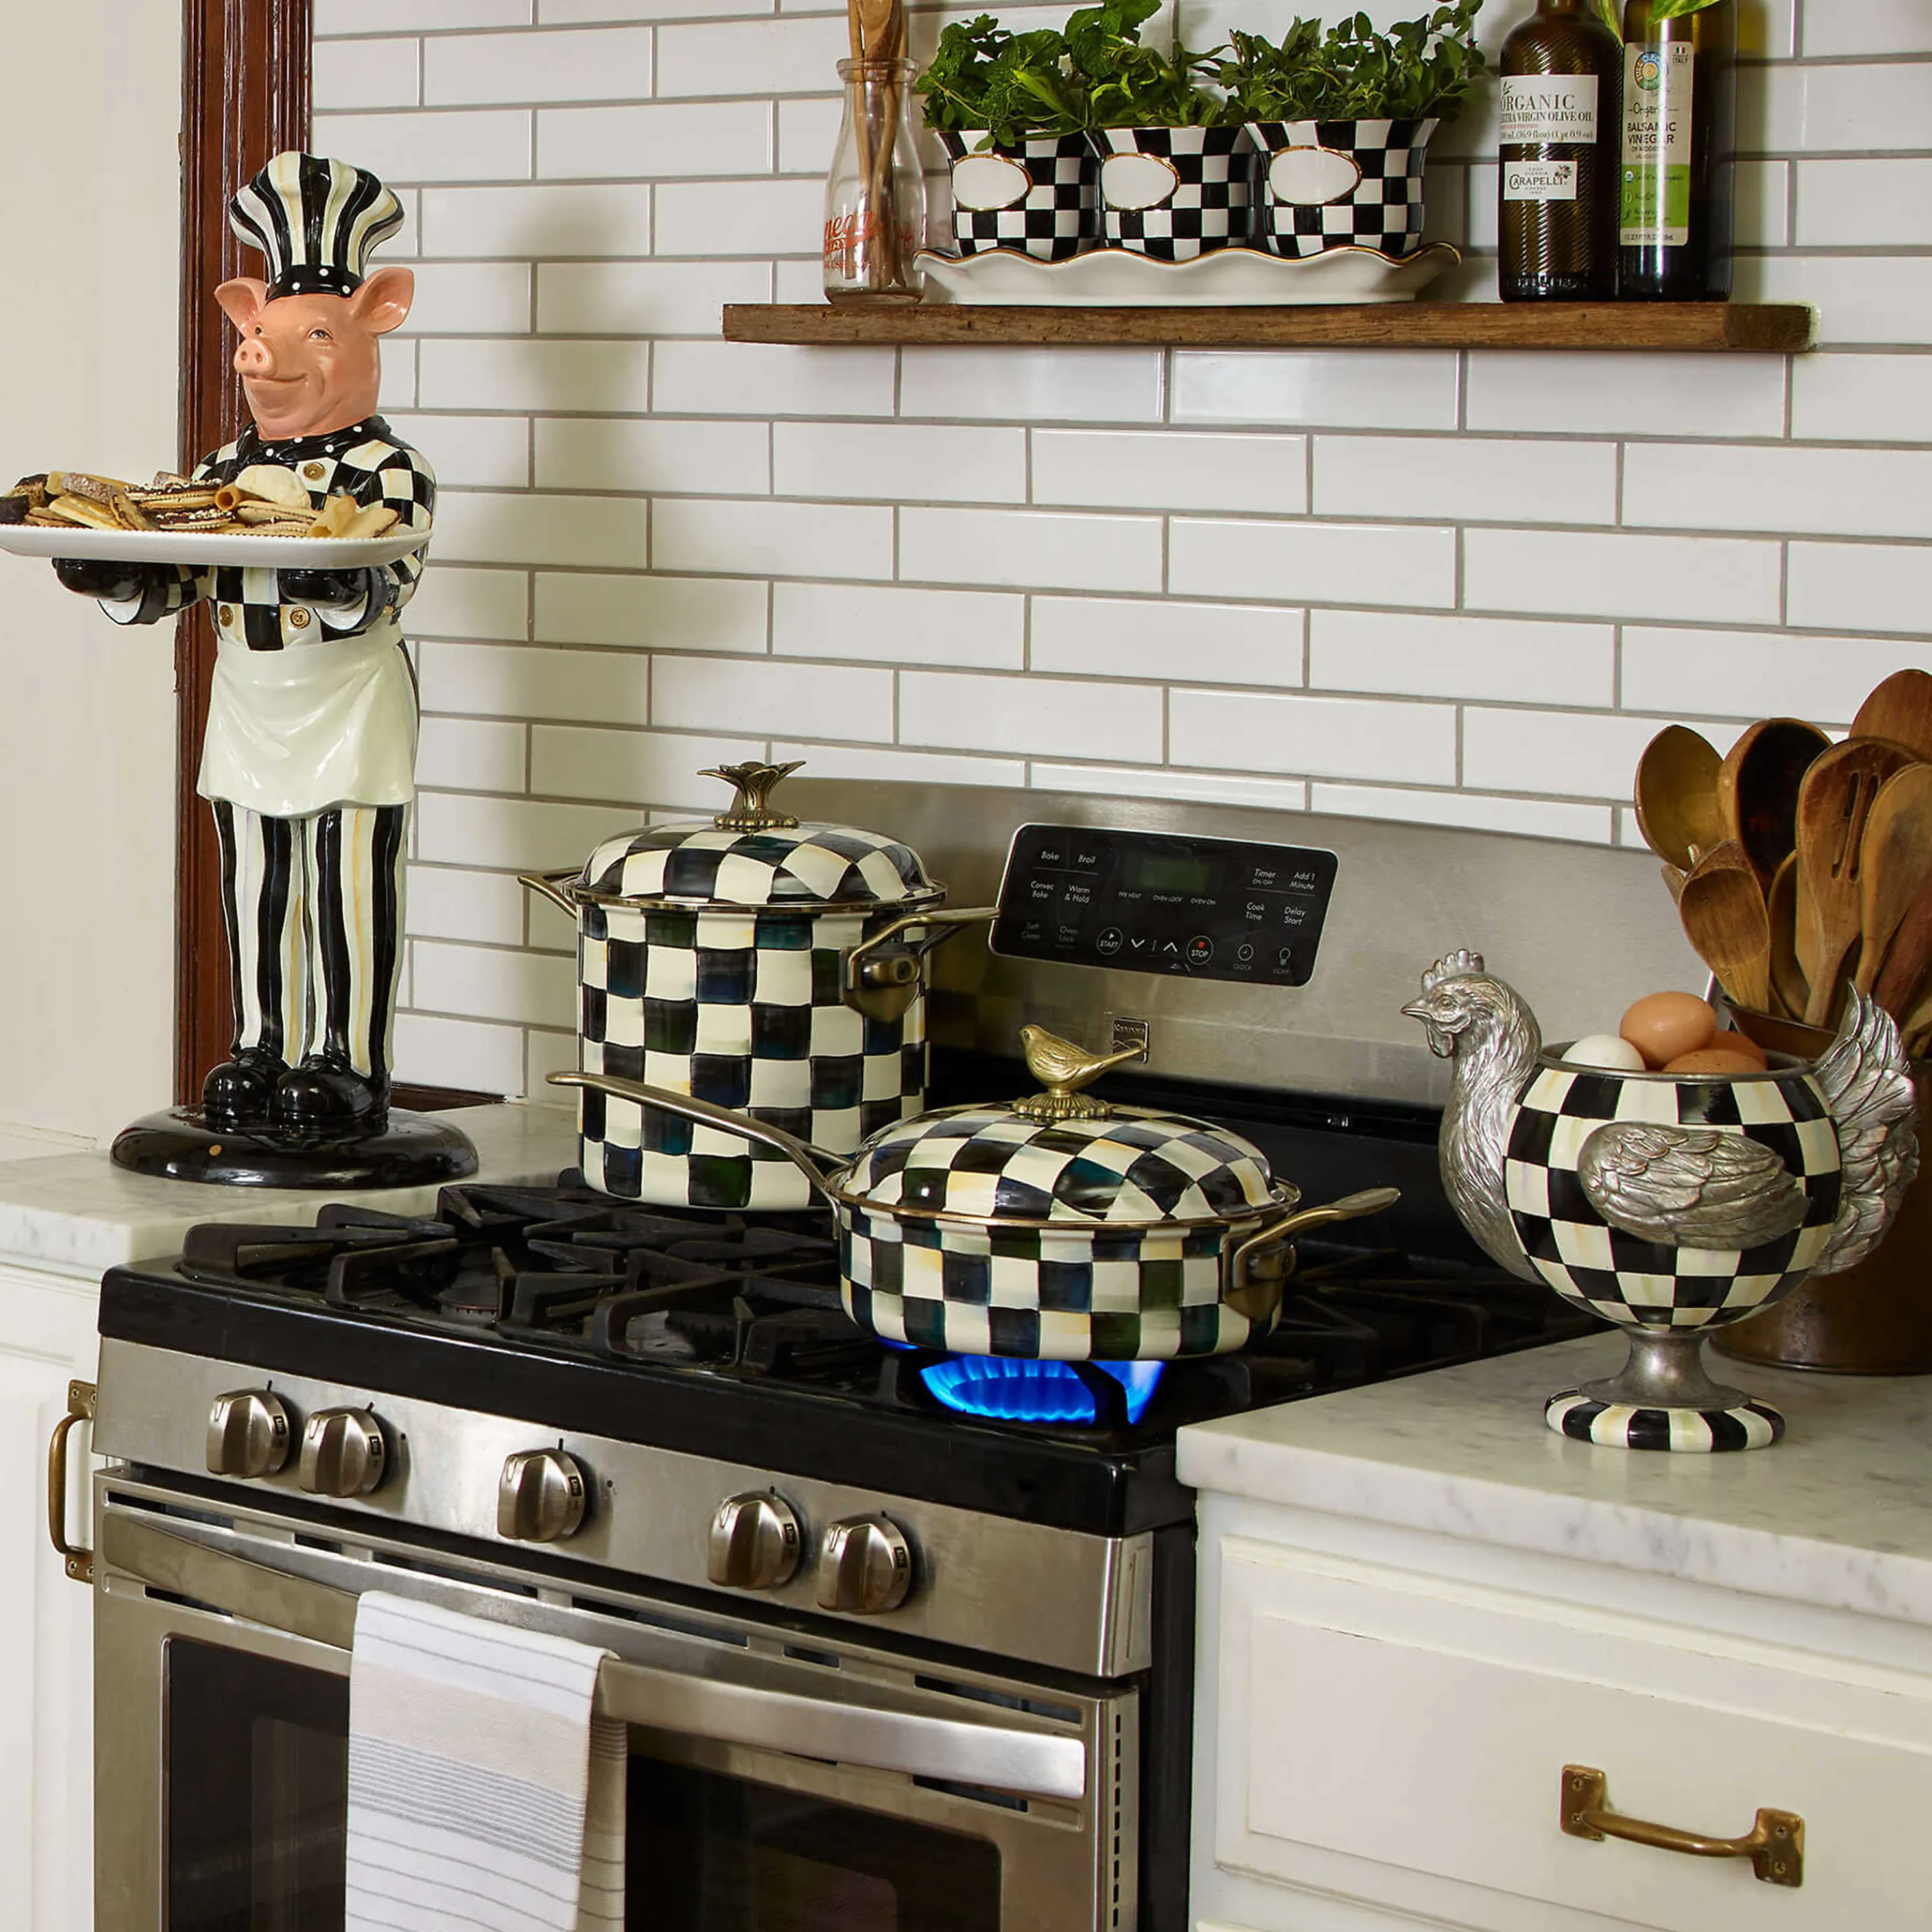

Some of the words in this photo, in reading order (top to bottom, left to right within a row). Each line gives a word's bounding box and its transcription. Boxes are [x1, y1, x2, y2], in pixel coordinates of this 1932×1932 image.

[1500, 94, 1575, 112] ORGANIC
[1634, 102, 1664, 117] Organ
[1516, 112, 1546, 123] VIRGIN
[1548, 112, 1577, 122] OLIVE
[1577, 112, 1594, 122] OIL
[1628, 134, 1675, 144] VINEGR
[1509, 173, 1563, 190] CARAPELLI
[1041, 850, 1059, 860] Bake
[1078, 854, 1096, 864] Broil
[1255, 868, 1277, 878] Timer
[1293, 871, 1310, 880] Add
[1312, 873, 1316, 882] 1
[1030, 880, 1055, 890] Convec
[1068, 884, 1090, 893] Warm
[1289, 881, 1315, 890] Minute
[1031, 890, 1049, 899] Bake
[1072, 894, 1090, 904] Hold
[1246, 902, 1266, 912] Cook
[1284, 906, 1308, 918] Delay
[1245, 911, 1262, 921] Time
[1284, 915, 1302, 926] Start
[1099, 940, 1119, 949] START
[1190, 948, 1209, 959] STOP
